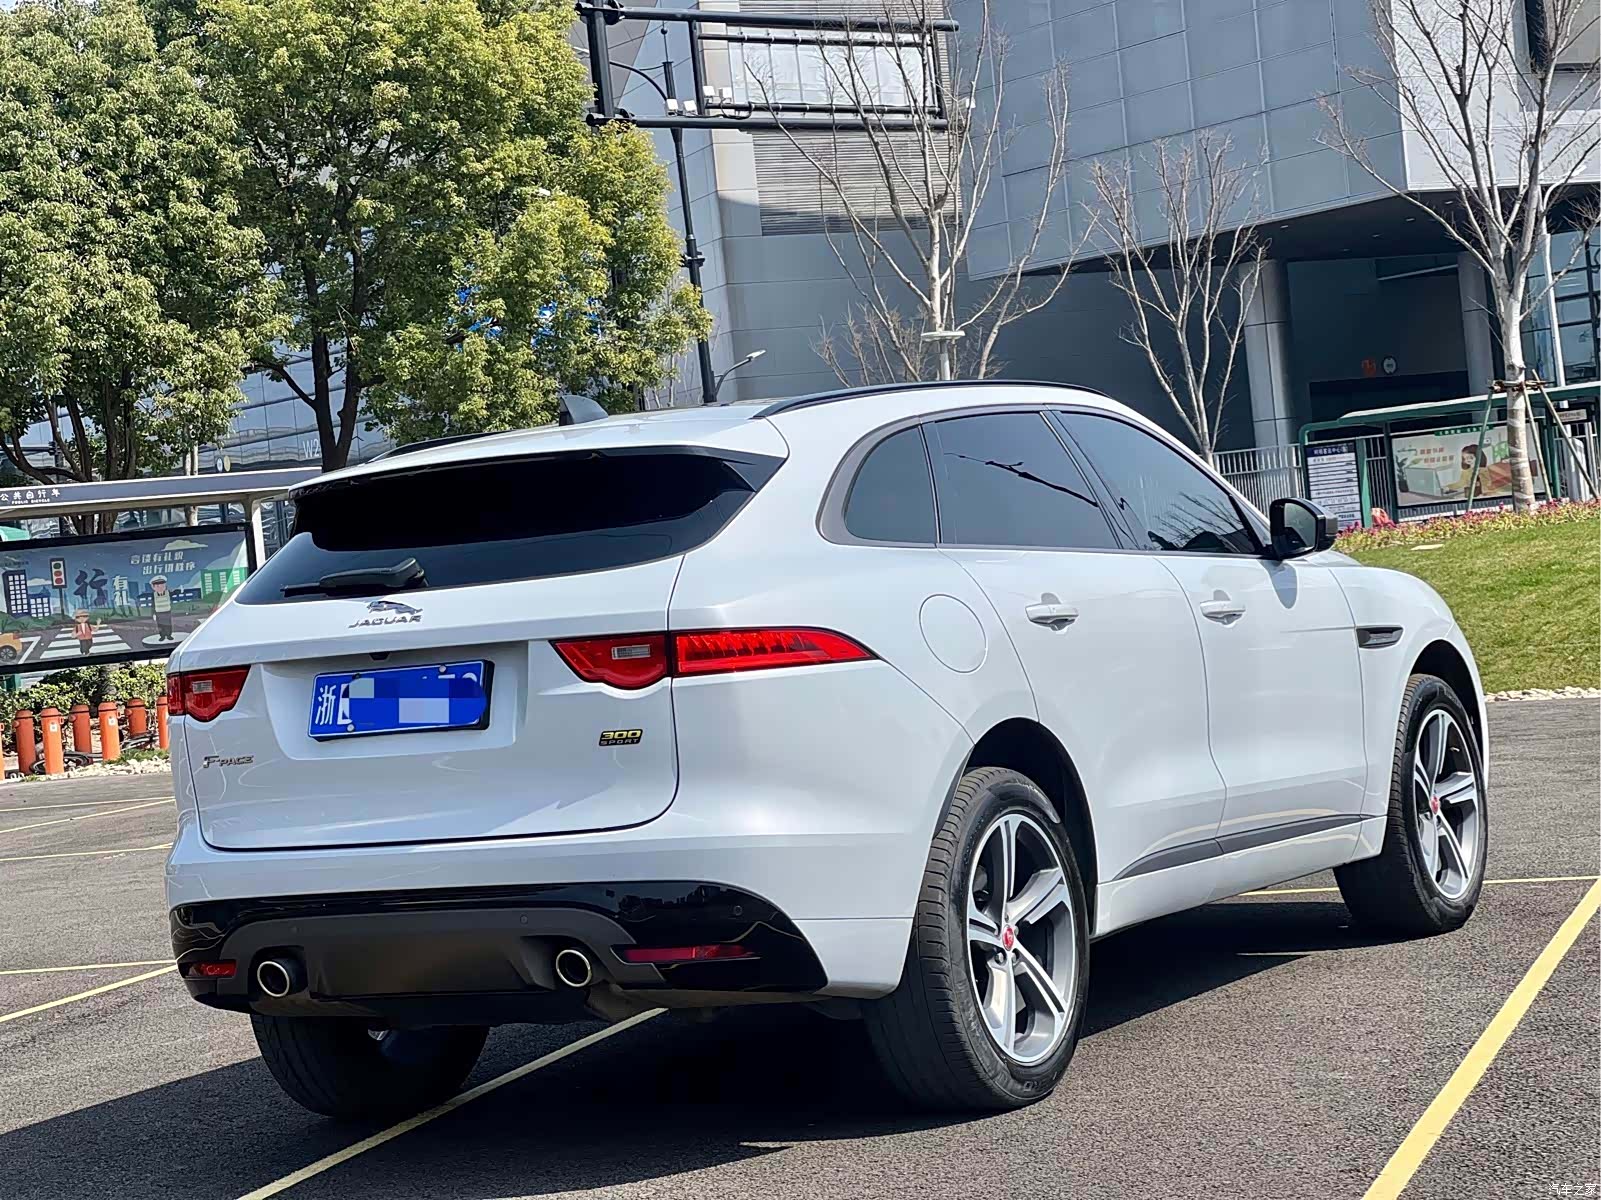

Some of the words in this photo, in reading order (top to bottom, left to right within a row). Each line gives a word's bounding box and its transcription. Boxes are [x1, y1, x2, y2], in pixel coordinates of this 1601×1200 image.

[0, 488, 60, 501] 公共自行车
[348, 614, 422, 629] JAGUAR
[601, 730, 641, 740] 300
[203, 755, 254, 768] F-PACE
